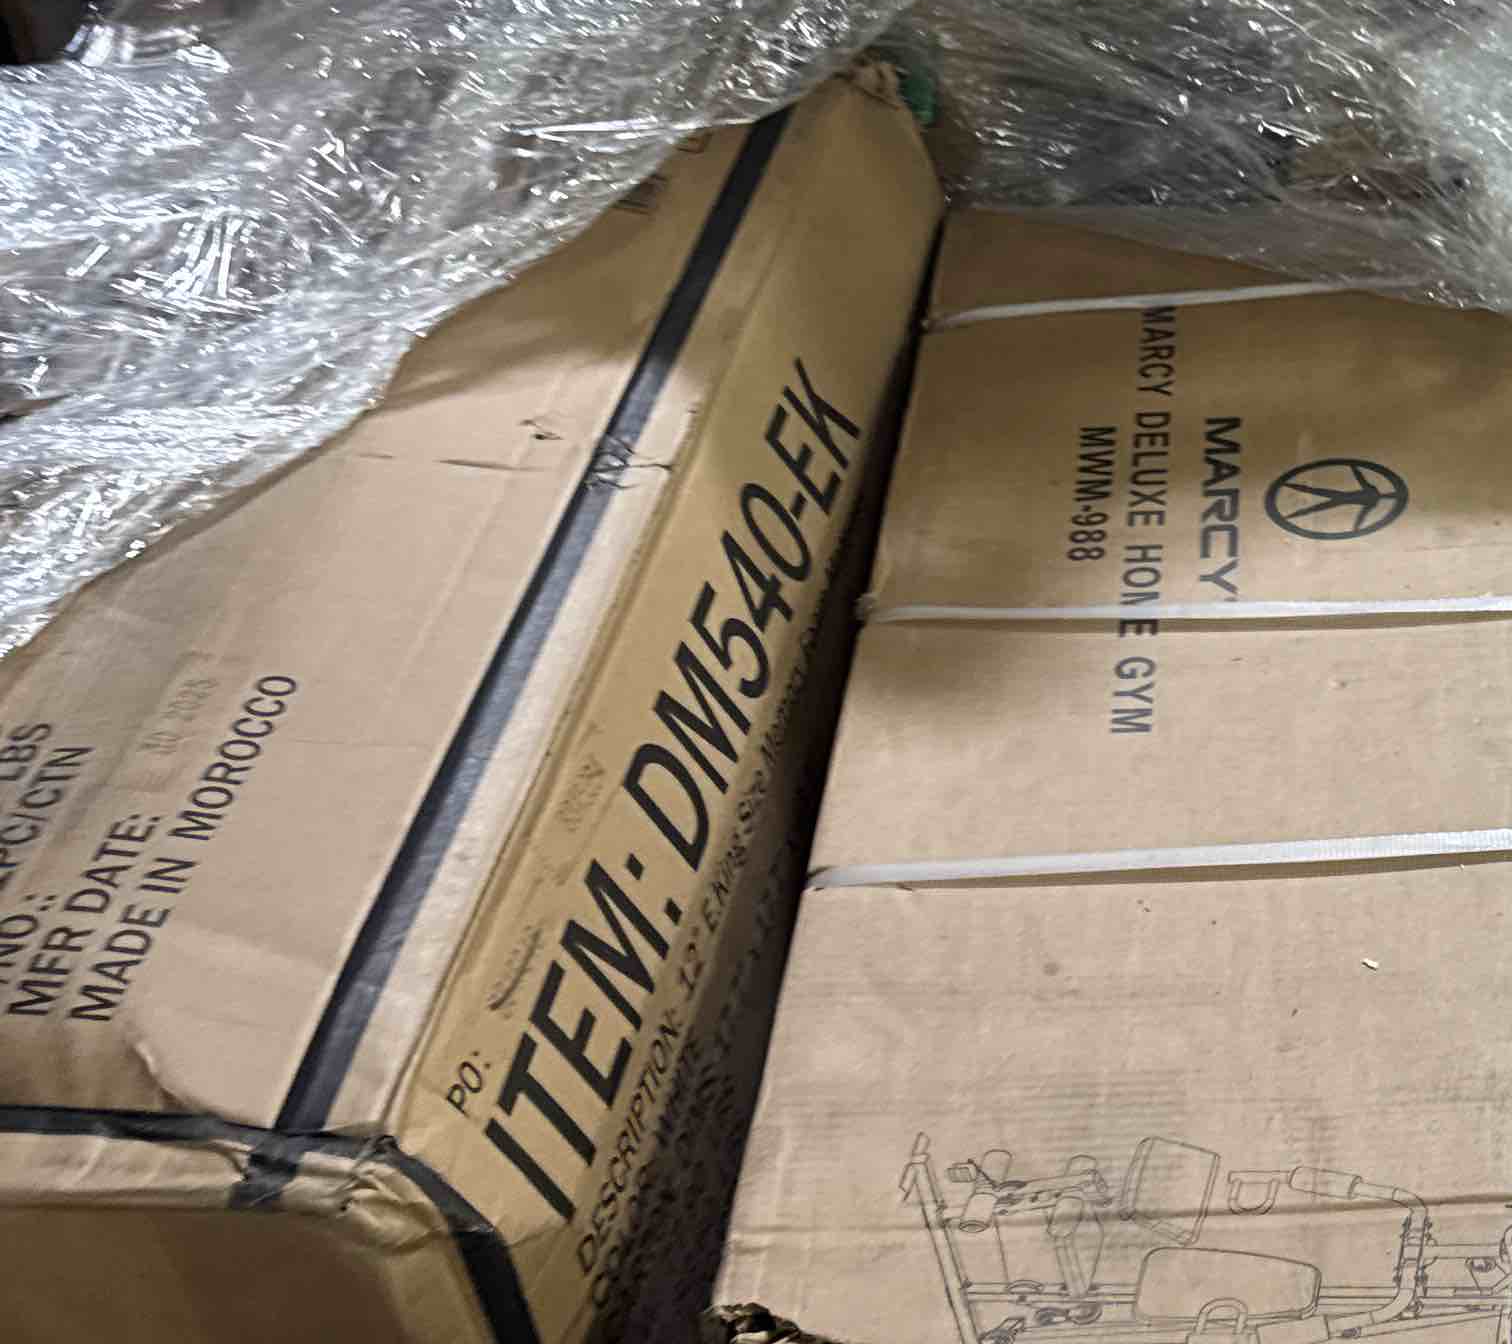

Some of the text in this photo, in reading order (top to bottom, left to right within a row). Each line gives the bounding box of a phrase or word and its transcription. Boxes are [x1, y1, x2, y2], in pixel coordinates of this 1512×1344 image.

[1136, 304, 1177, 399] MARCY
[1066, 425, 1119, 562] MWM-988
[1126, 411, 1171, 529] DELUXE
[1199, 416, 1243, 595] MARCY
[1109, 655, 1156, 735] GYM
[67, 674, 298, 1023] MADE IN MOROCCO
[484, 852, 684, 1226] ITEM:
[623, 356, 861, 873] DM540-EK
[6, 924, 95, 1017] MFR
[64, 811, 163, 915] DATE:
